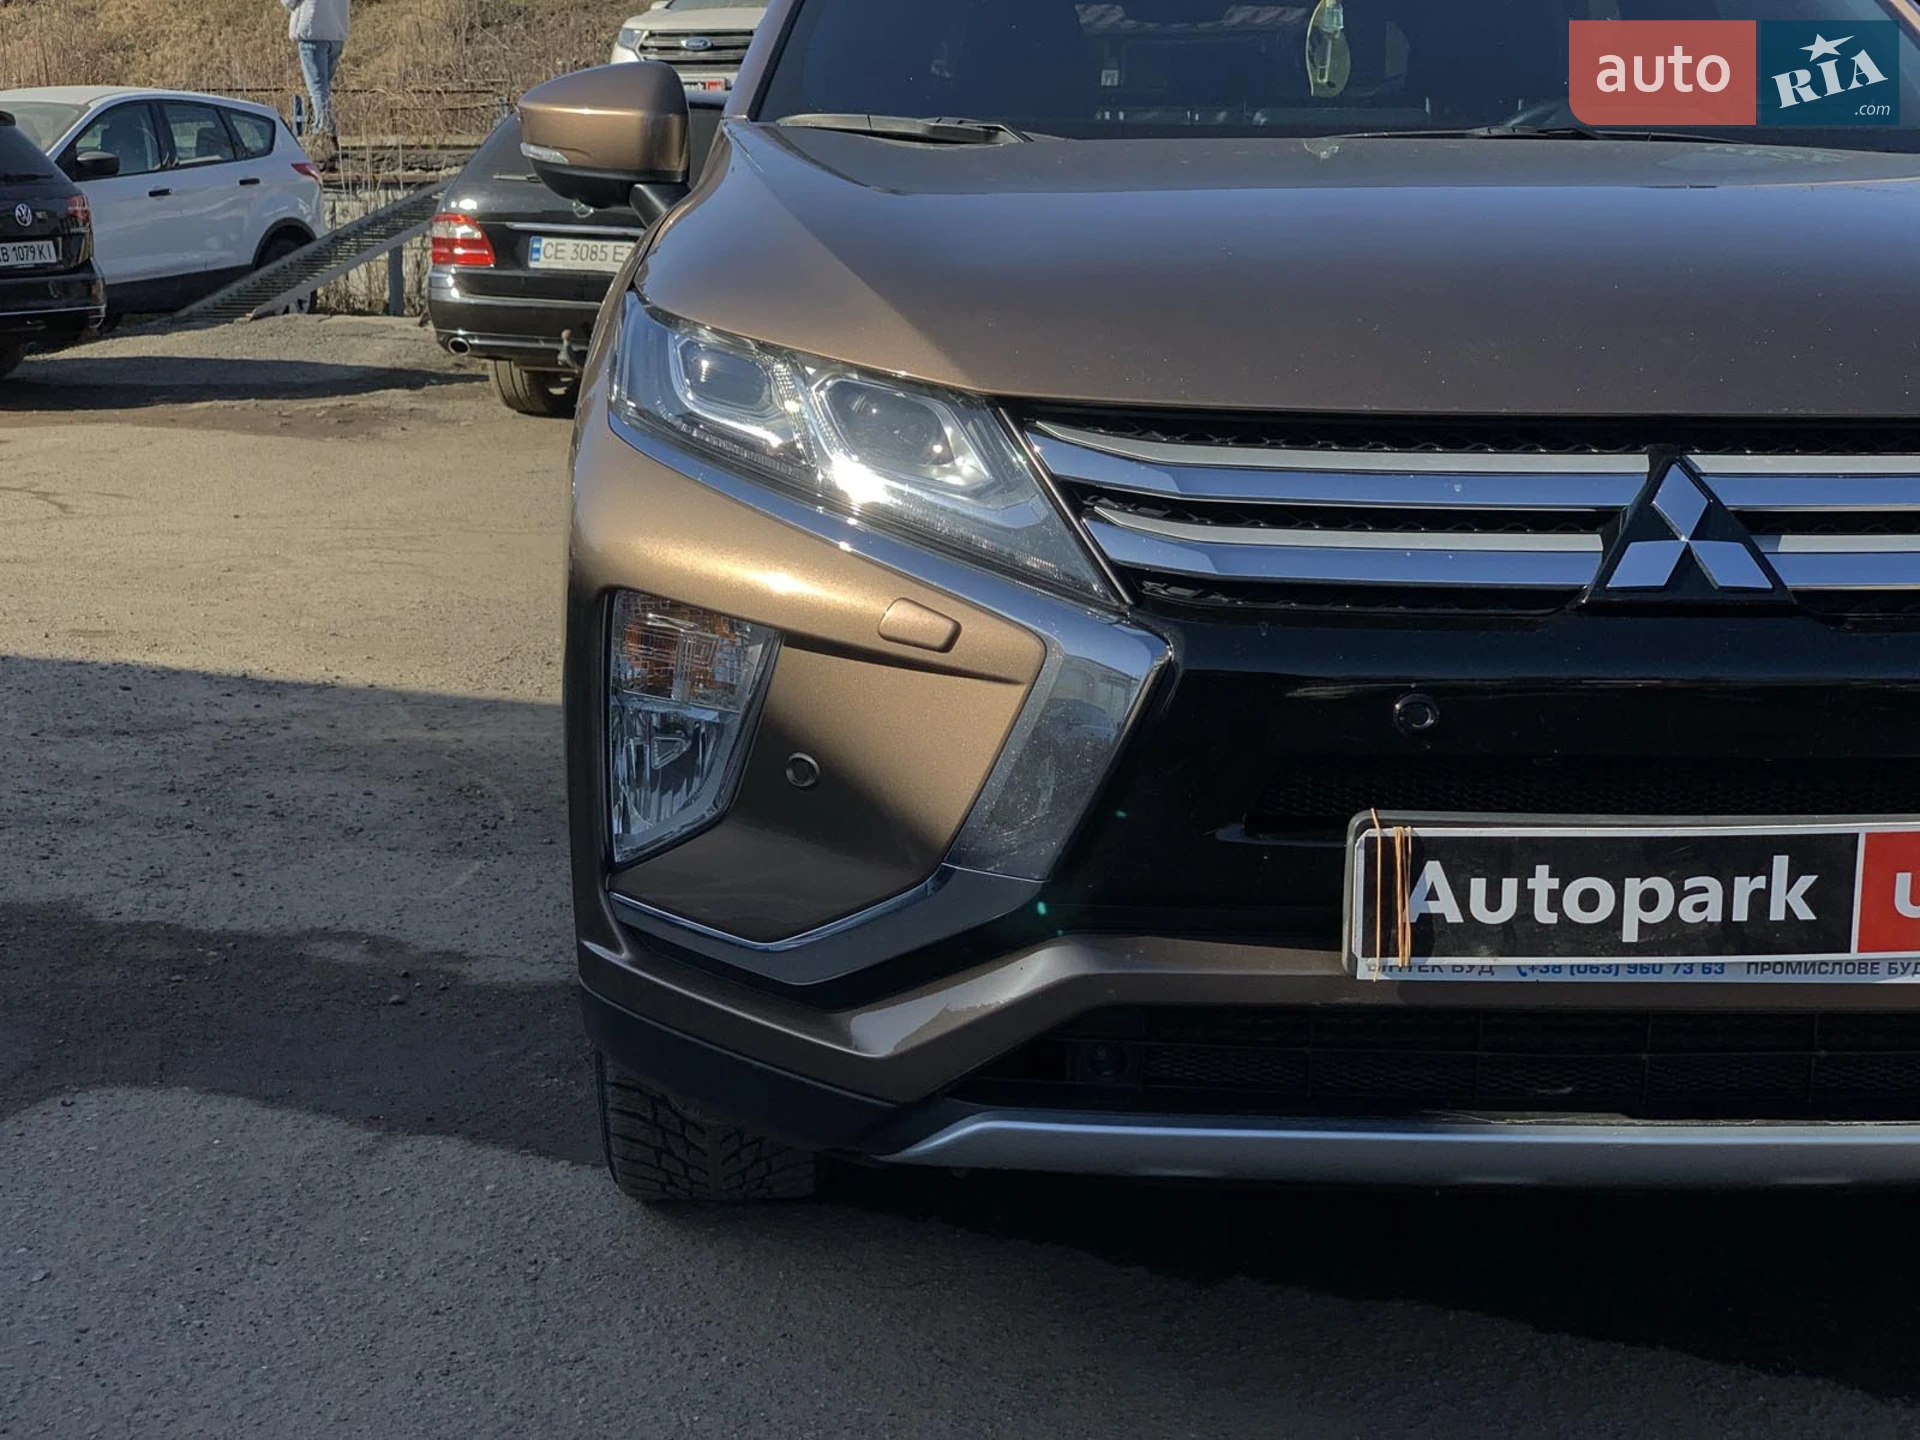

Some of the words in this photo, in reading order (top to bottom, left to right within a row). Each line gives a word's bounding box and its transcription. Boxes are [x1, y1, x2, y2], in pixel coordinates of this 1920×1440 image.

[0, 246, 9, 262] B
[12, 245, 36, 262] 1079
[543, 242, 565, 260] CE
[570, 243, 608, 262] 3085
[613, 245, 634, 263] E
[1404, 854, 1819, 943] Autopark
[1746, 961, 1881, 976] ПРОМИСЛОВЕ
